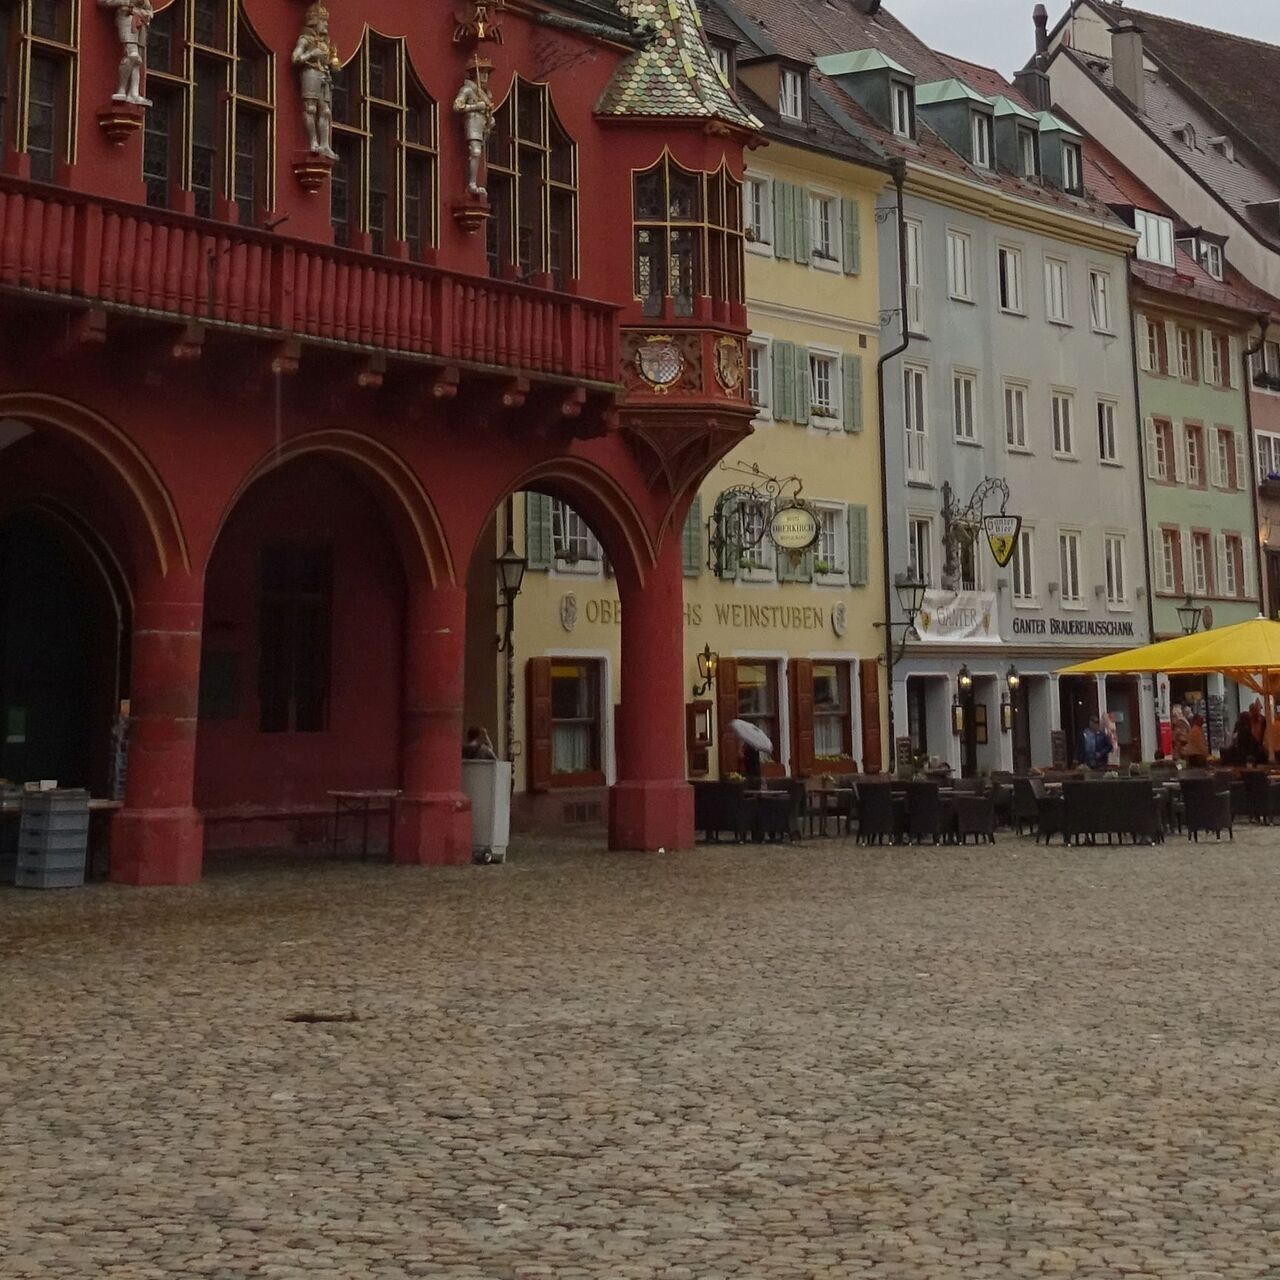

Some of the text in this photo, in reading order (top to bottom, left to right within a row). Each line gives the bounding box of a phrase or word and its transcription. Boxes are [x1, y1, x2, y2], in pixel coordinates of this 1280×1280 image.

[715, 603, 825, 630] WEINSTUBEN
[936, 605, 977, 628] GANTER
[1013, 617, 1046, 634] GANTER
